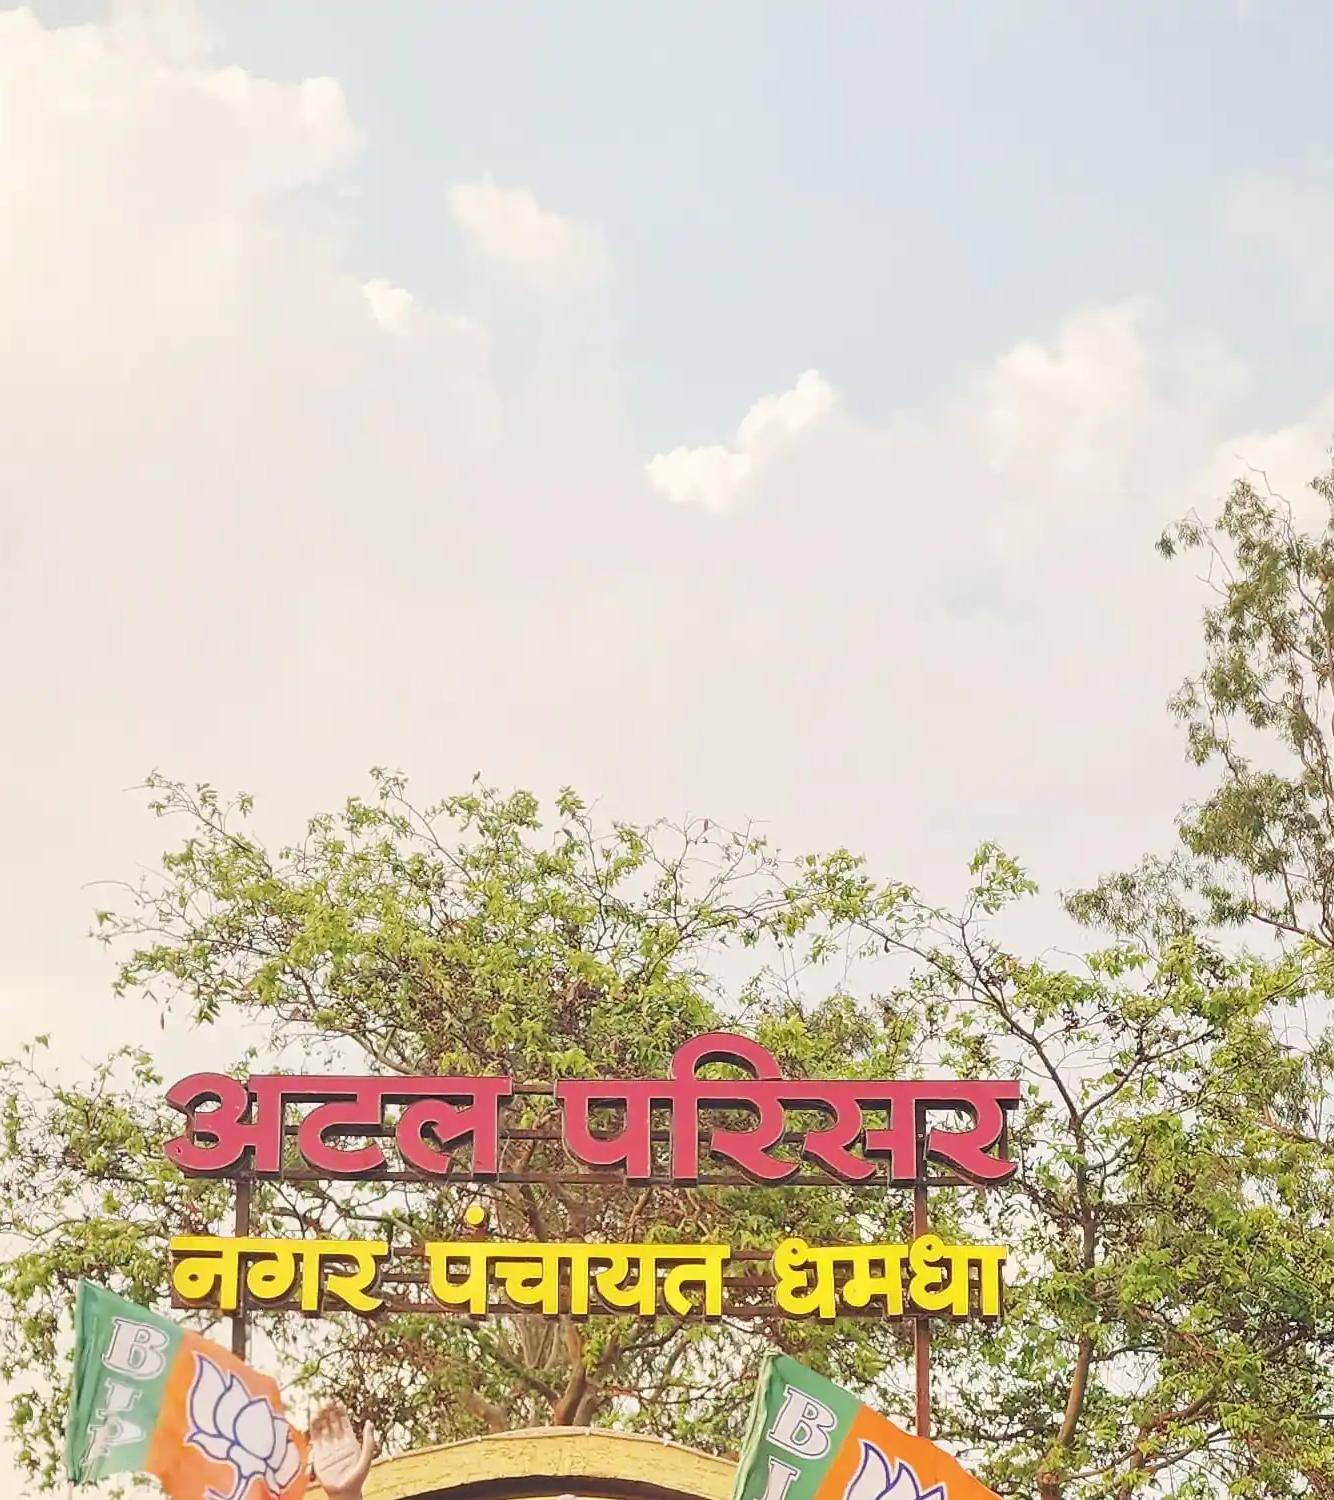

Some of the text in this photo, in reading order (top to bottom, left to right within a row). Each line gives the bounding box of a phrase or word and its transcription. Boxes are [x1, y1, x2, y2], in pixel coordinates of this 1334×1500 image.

[164, 1031, 1021, 1185] अटल परिसर
[170, 1206, 1008, 1321] नगर पंचायत धमधा
[78, 1317, 170, 1467] BJP
